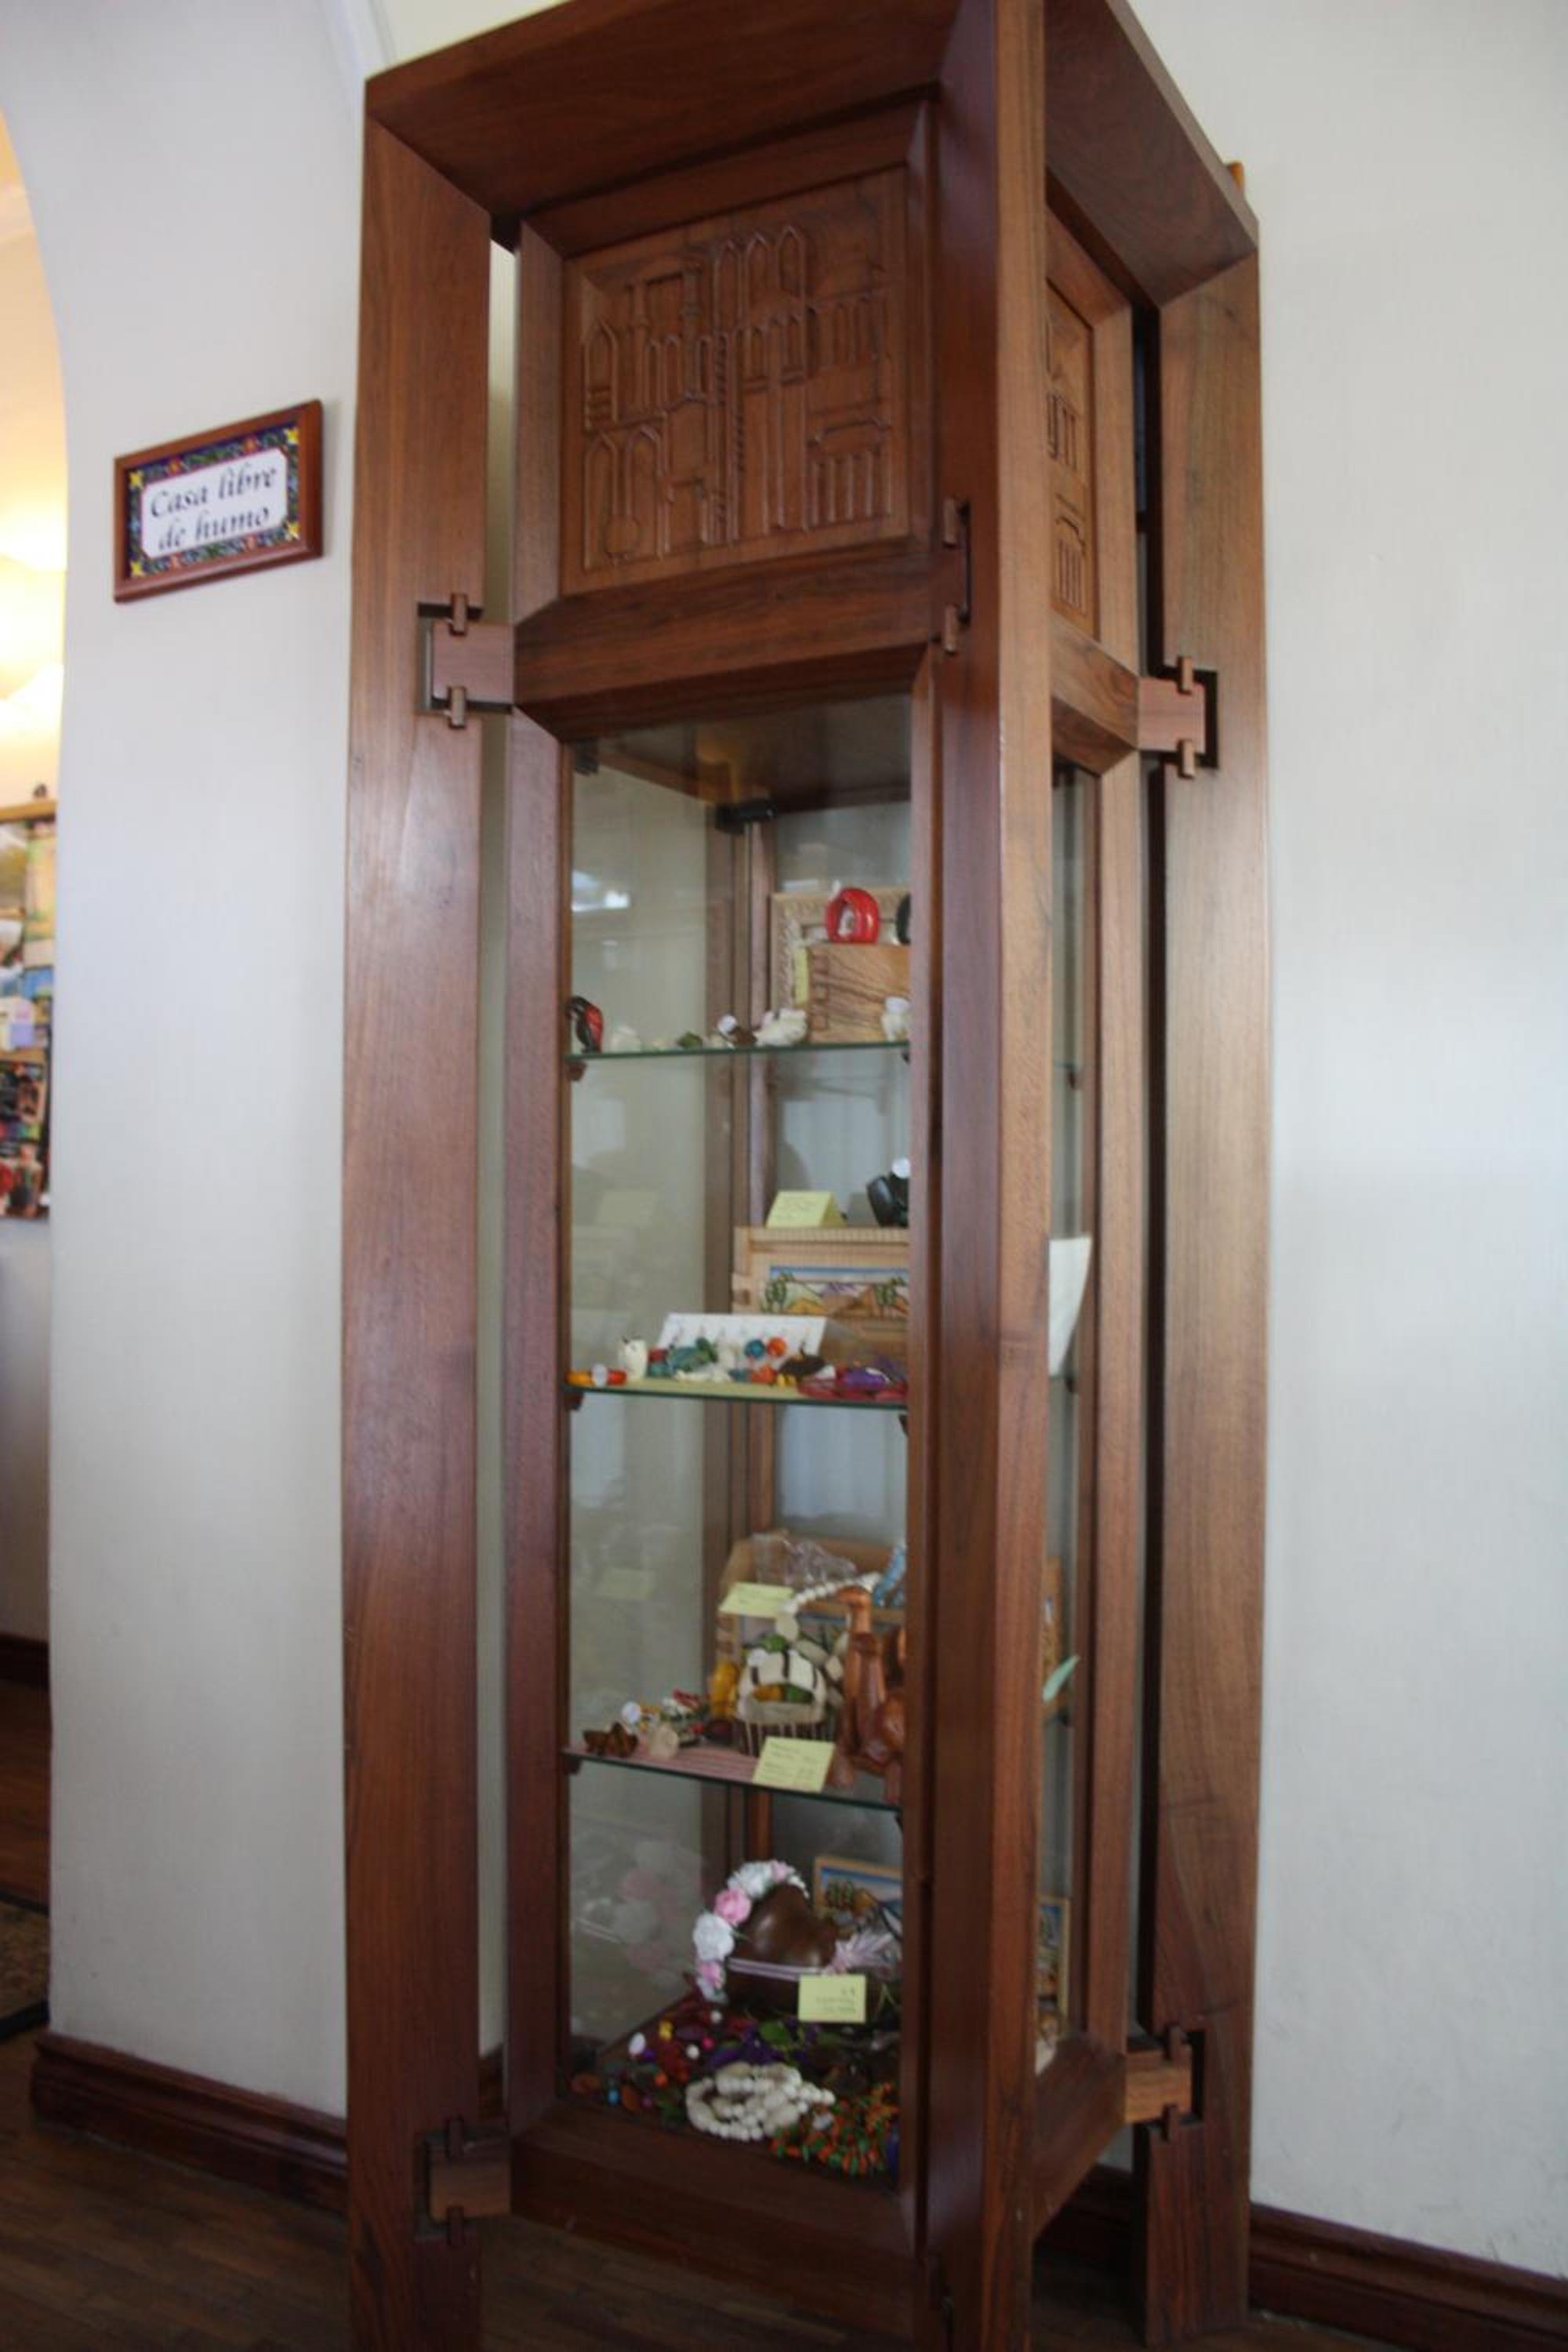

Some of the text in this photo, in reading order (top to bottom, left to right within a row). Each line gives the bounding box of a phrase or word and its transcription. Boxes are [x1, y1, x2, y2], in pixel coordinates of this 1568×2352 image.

[151, 463, 278, 517] Casa libre
[158, 507, 270, 550] de humo
